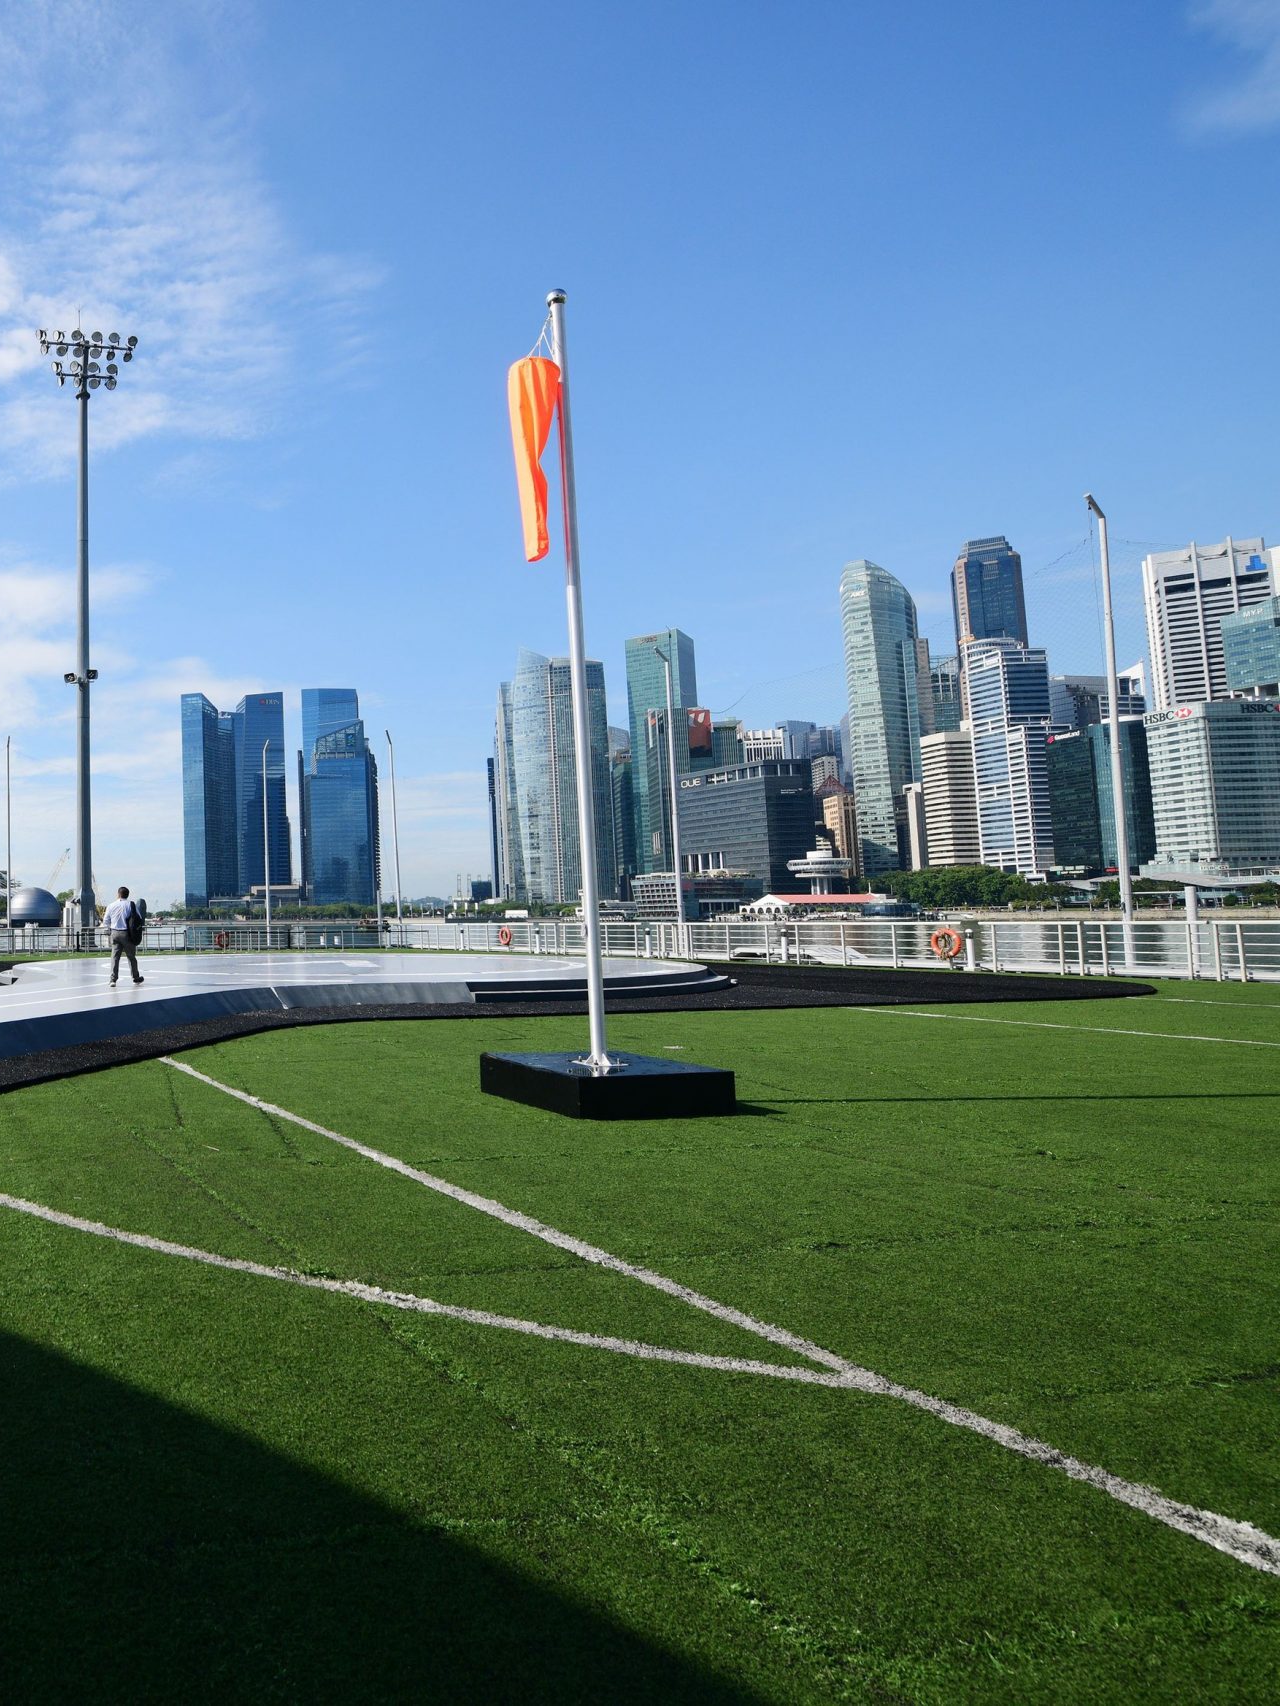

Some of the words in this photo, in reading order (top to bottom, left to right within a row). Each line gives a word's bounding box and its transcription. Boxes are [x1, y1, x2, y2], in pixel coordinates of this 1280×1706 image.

[1241, 703, 1274, 714] HSBC
[1144, 710, 1175, 725] HSBC
[680, 777, 701, 789] OUE
